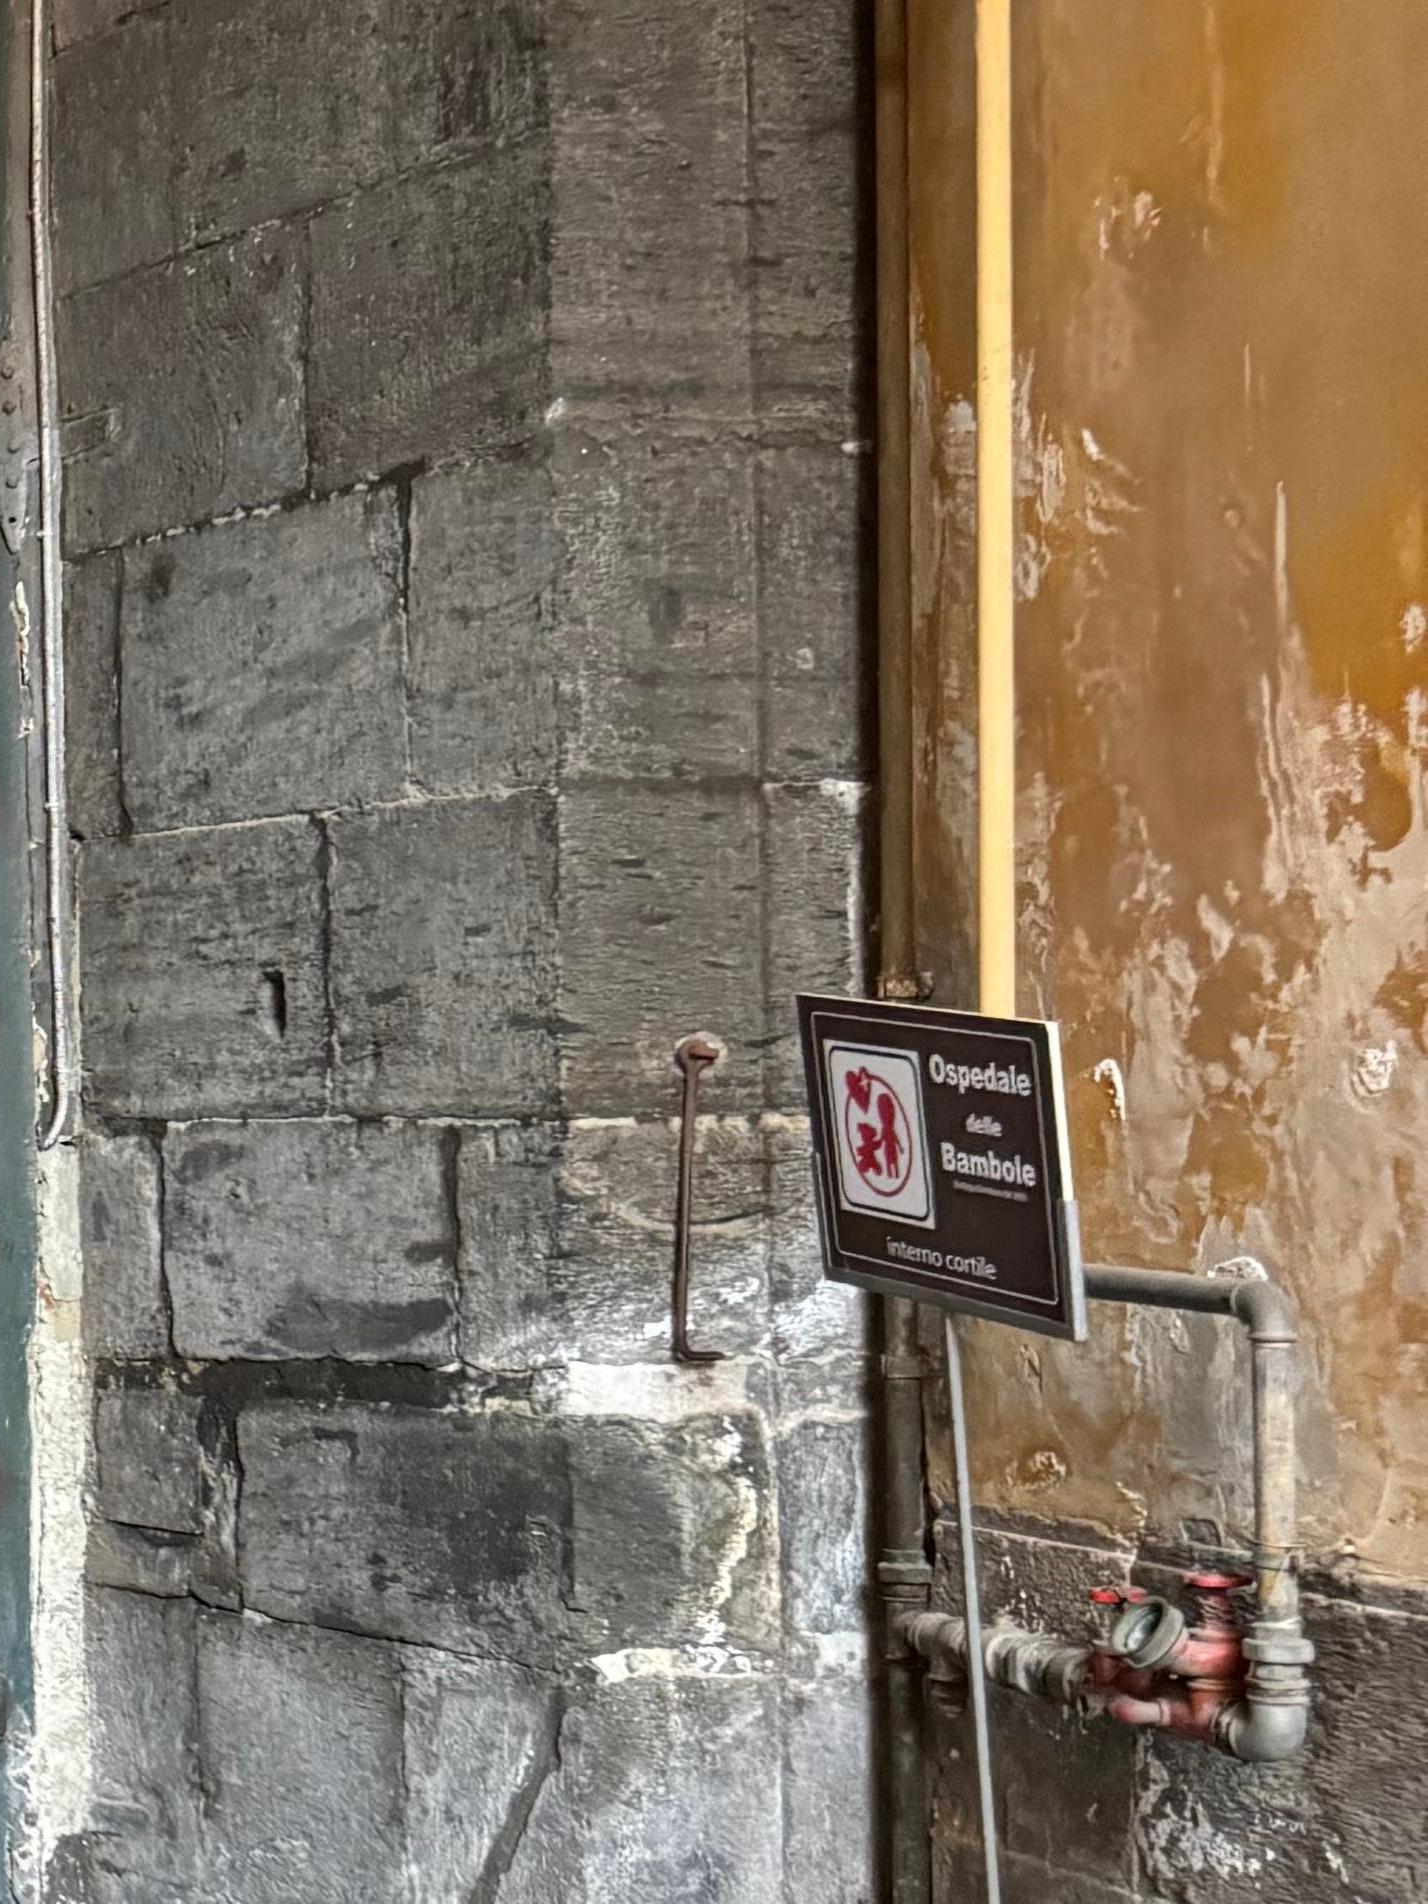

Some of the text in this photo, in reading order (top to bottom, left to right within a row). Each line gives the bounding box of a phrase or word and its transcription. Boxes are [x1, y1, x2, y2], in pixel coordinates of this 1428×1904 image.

[929, 1053, 1032, 1096] Ospedale
[965, 1113, 1002, 1137] delle
[941, 1142, 1036, 1187] Bambole
[886, 1236, 997, 1280] interno cortile
